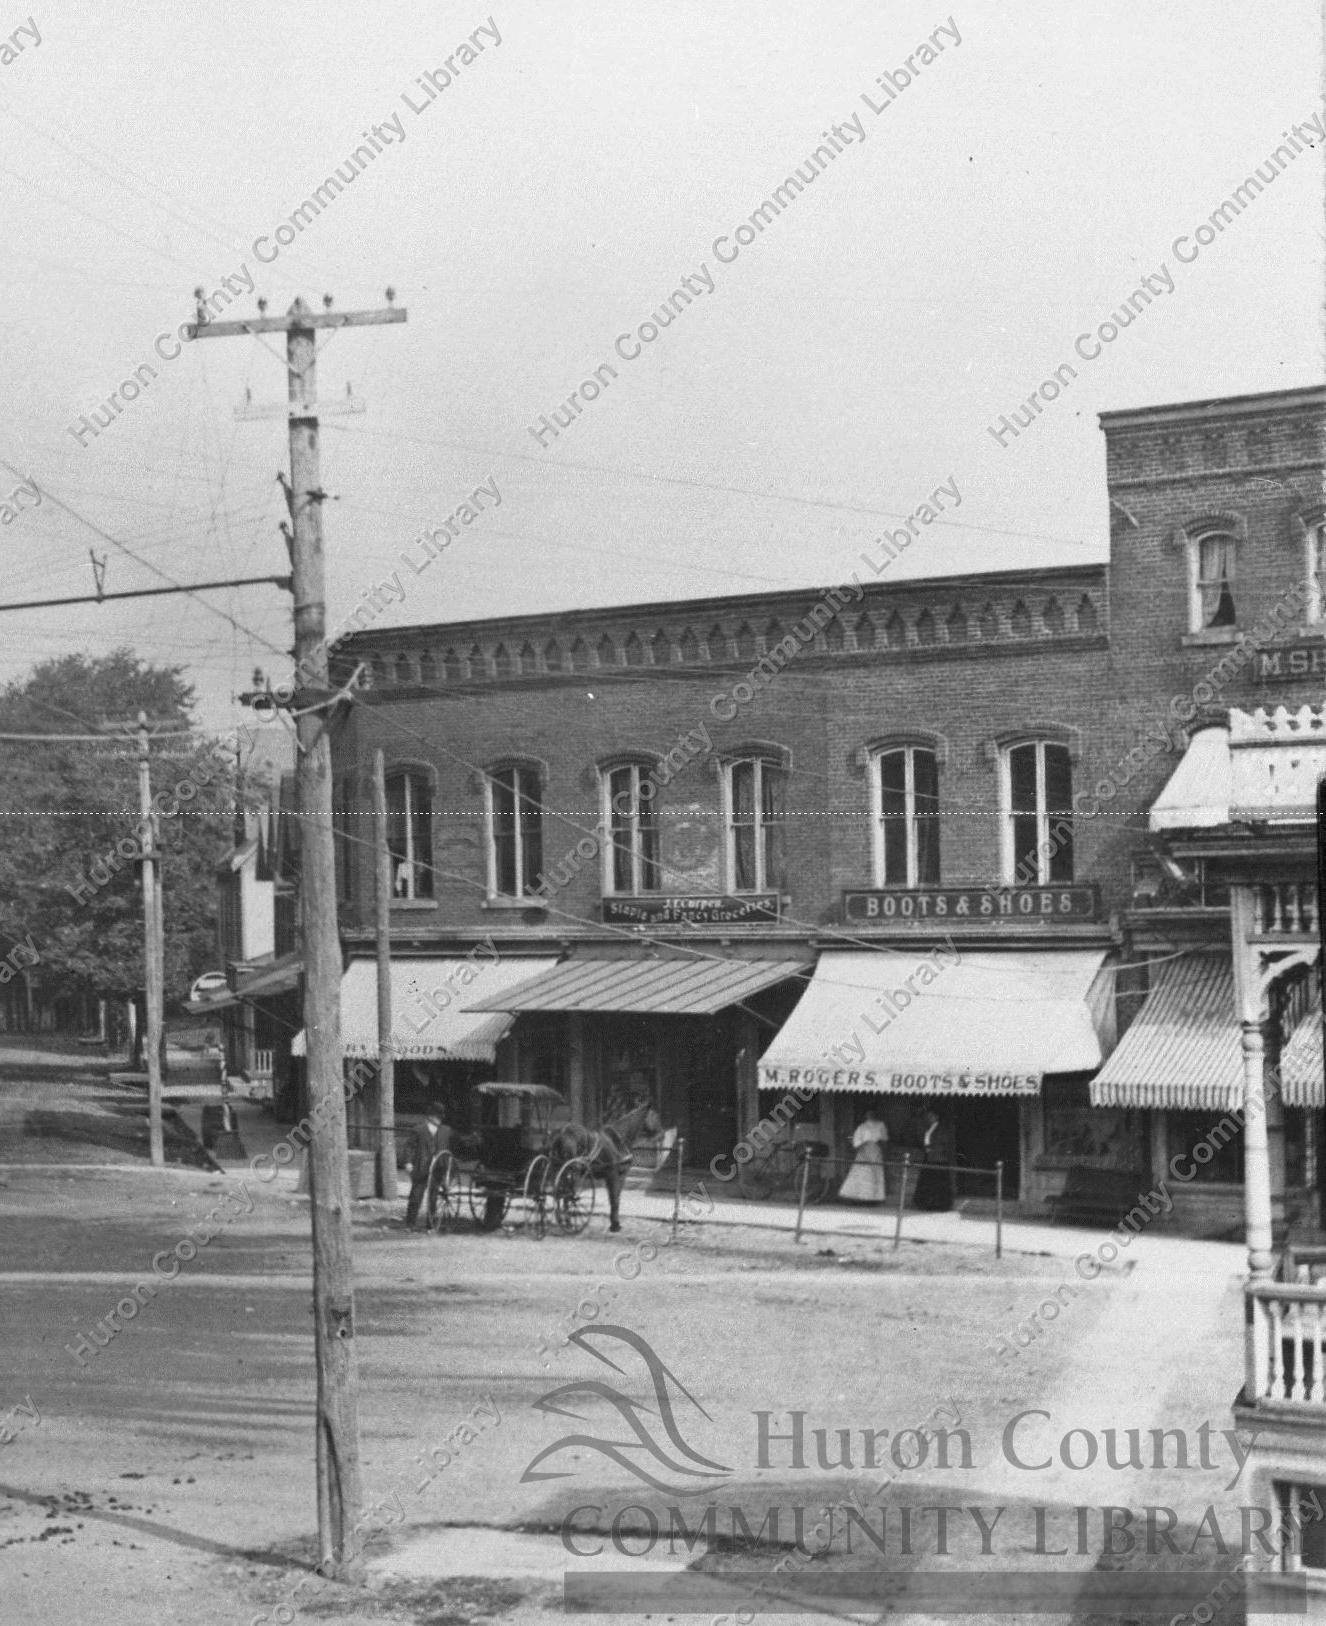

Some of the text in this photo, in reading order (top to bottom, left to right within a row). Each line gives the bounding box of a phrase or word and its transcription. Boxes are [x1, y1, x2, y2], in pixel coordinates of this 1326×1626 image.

[609, 901, 648, 921] Staple
[649, 908, 671, 924] and
[673, 908, 709, 922] Fancy
[866, 895, 948, 917] BOOTS
[955, 895, 971, 916] &
[890, 1073, 954, 1089] BOOTS
[973, 1074, 1040, 1090] SHOES
